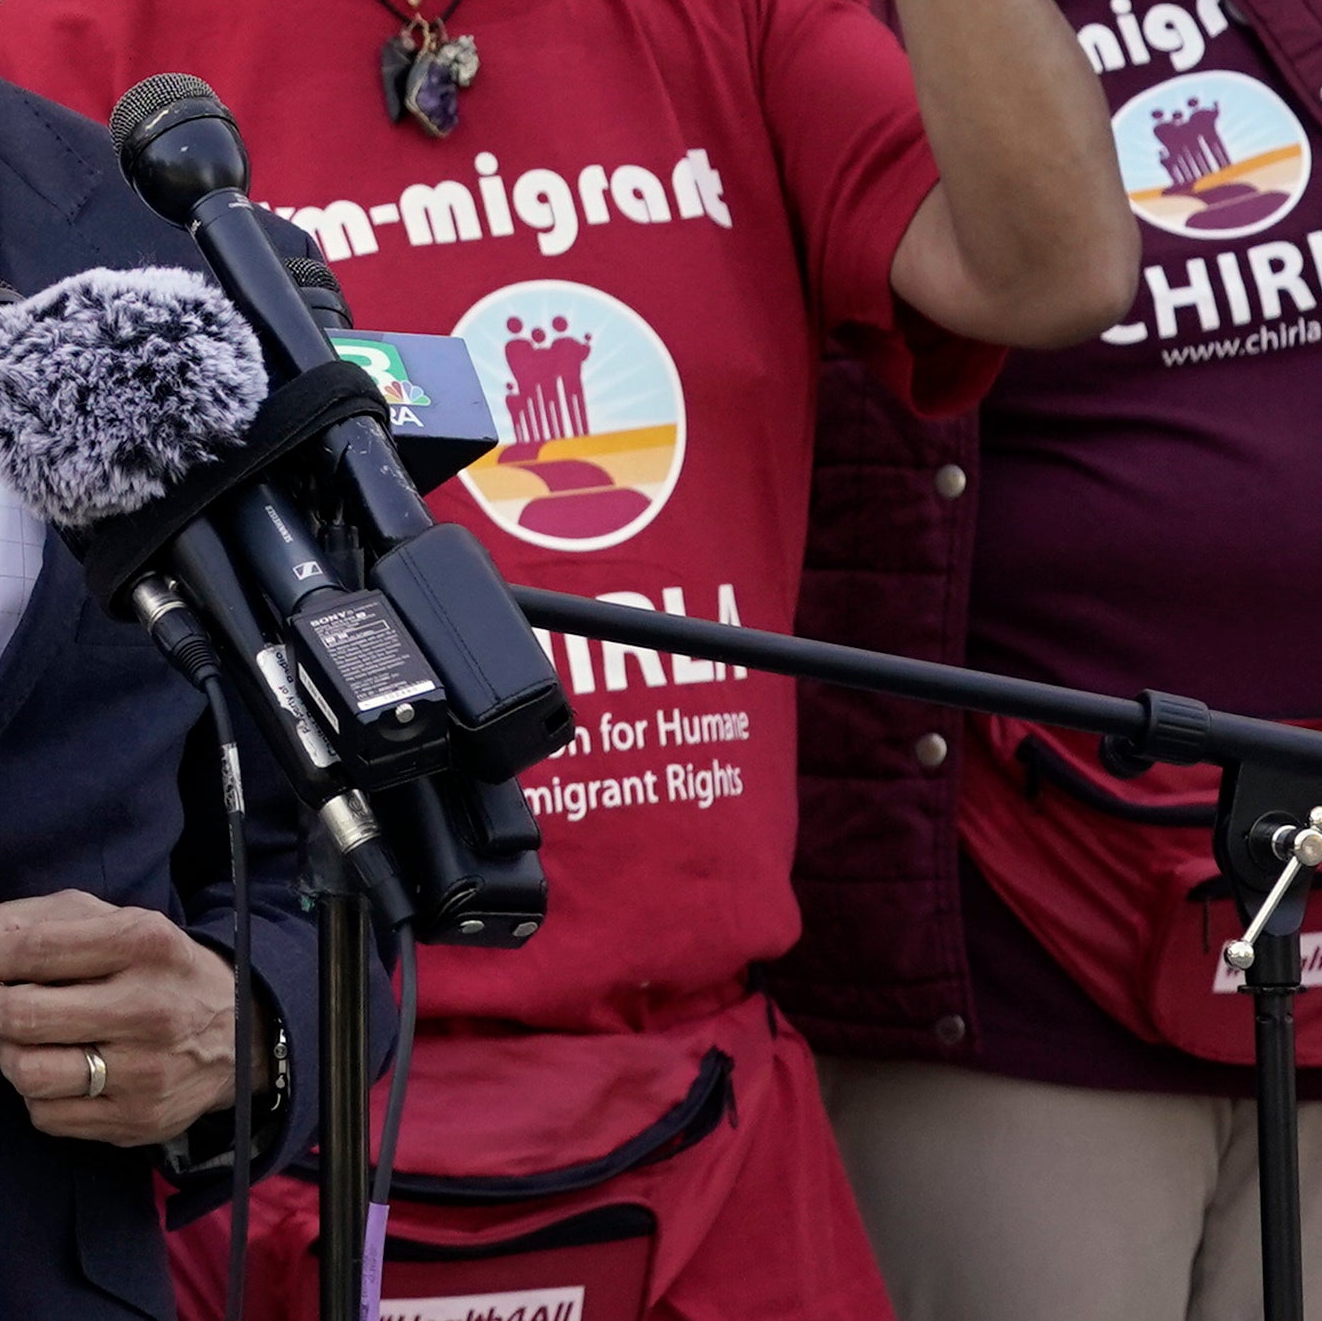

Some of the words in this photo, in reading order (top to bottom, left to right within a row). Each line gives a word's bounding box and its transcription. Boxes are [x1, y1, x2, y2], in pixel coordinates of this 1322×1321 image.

[258, 148, 733, 263] m-migrant
[390, 406, 424, 427] RA
[310, 611, 346, 627] SONY
[601, 712, 648, 753] for
[657, 708, 750, 746] Humane
[524, 770, 659, 822] migrant
[666, 739, 744, 809] Rights
